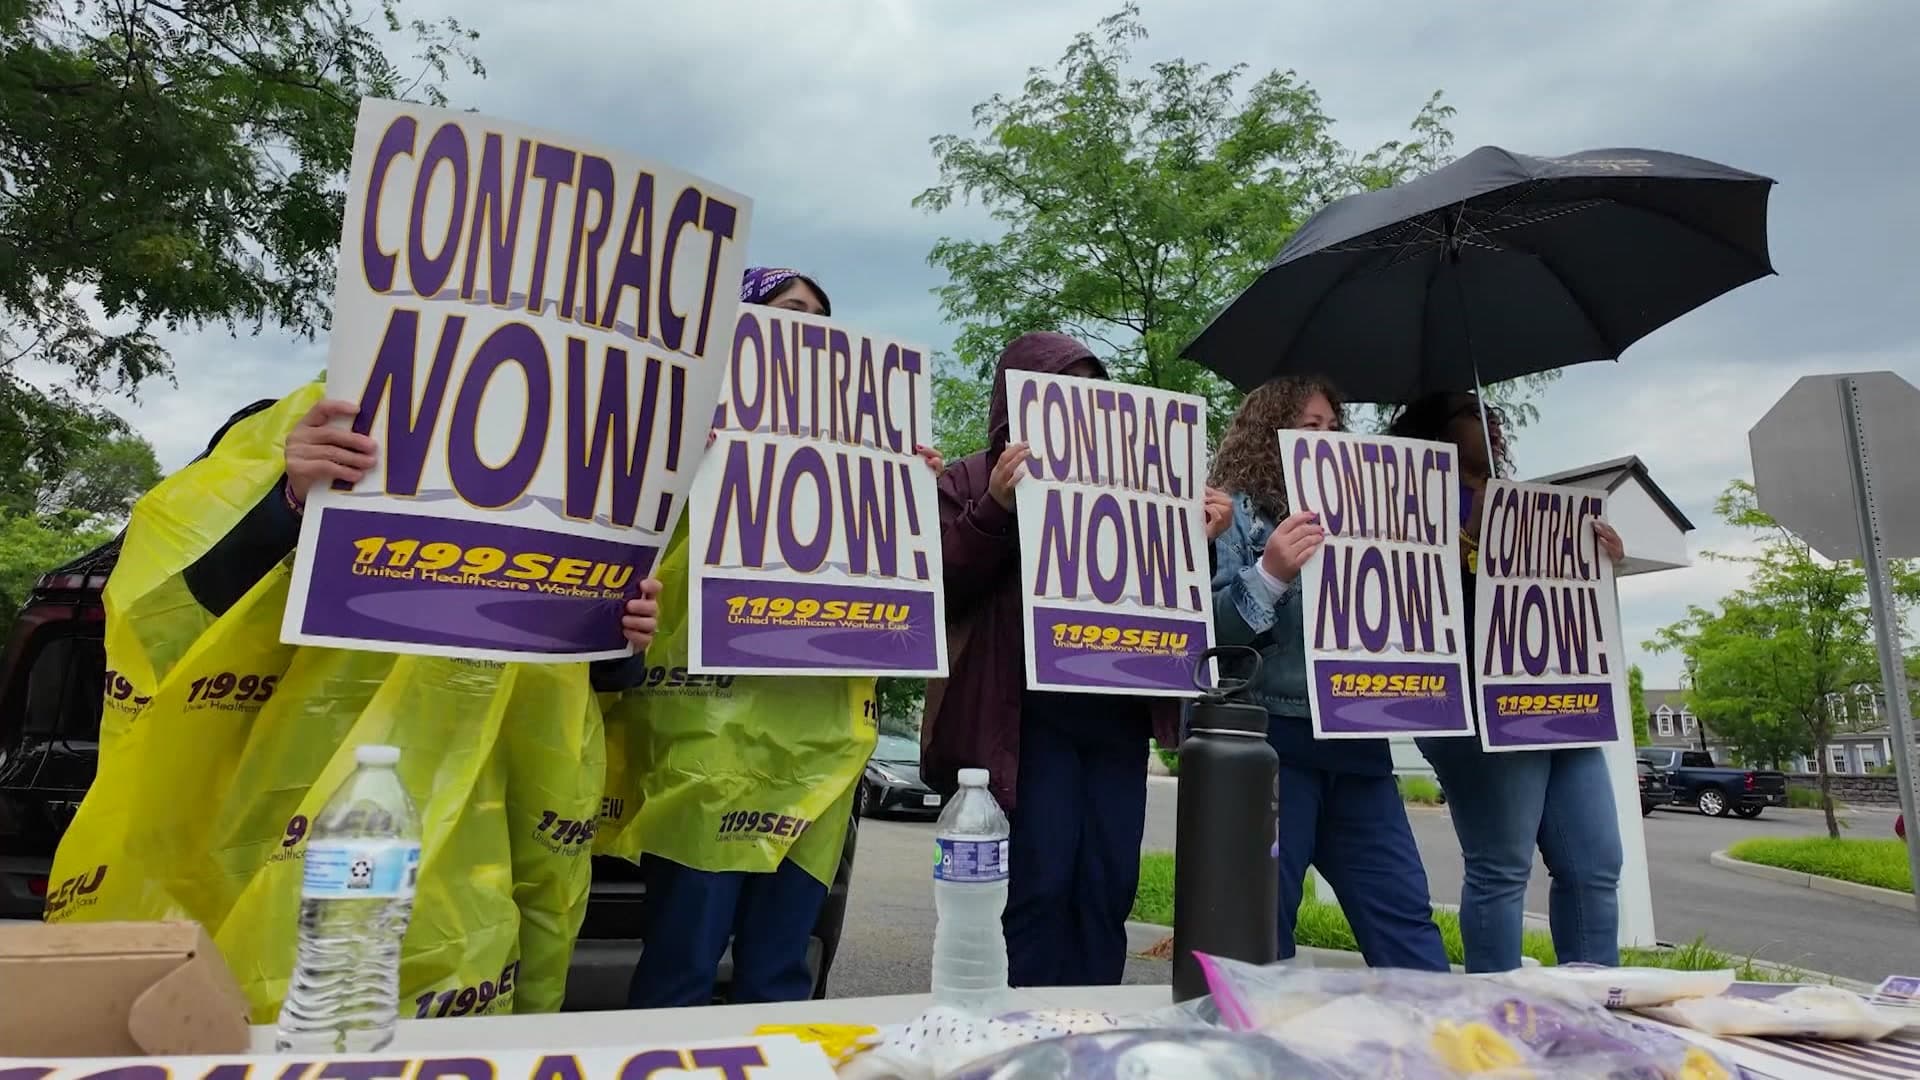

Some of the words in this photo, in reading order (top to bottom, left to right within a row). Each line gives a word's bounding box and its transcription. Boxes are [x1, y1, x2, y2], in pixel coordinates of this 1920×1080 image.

[361, 115, 737, 359] CONTRACT
[328, 306, 688, 536] NOW!
[711, 312, 922, 456] ONTRACT
[1019, 379, 1198, 499] CONTRACT
[704, 439, 930, 581] NOW!
[1293, 437, 1451, 546] CONTRACT
[1485, 487, 1603, 581] CONTRACT
[351, 563, 416, 580] United
[421, 567, 530, 591] Healthcare
[535, 581, 599, 599] Workers
[353, 537, 634, 589] 1199SEIU
[1033, 489, 1203, 612] NOW!
[726, 596, 911, 622] 1199SEIU
[728, 614, 769, 625] United
[773, 616, 836, 628] Healthcare
[839, 619, 885, 630] Workers
[1051, 623, 1189, 649] 1199SEIU
[1314, 543, 1457, 654] NOW!
[1483, 584, 1609, 675] NOW!
[1330, 673, 1446, 691] 1199SEIU
[1496, 694, 1599, 710] 1199SEIU
